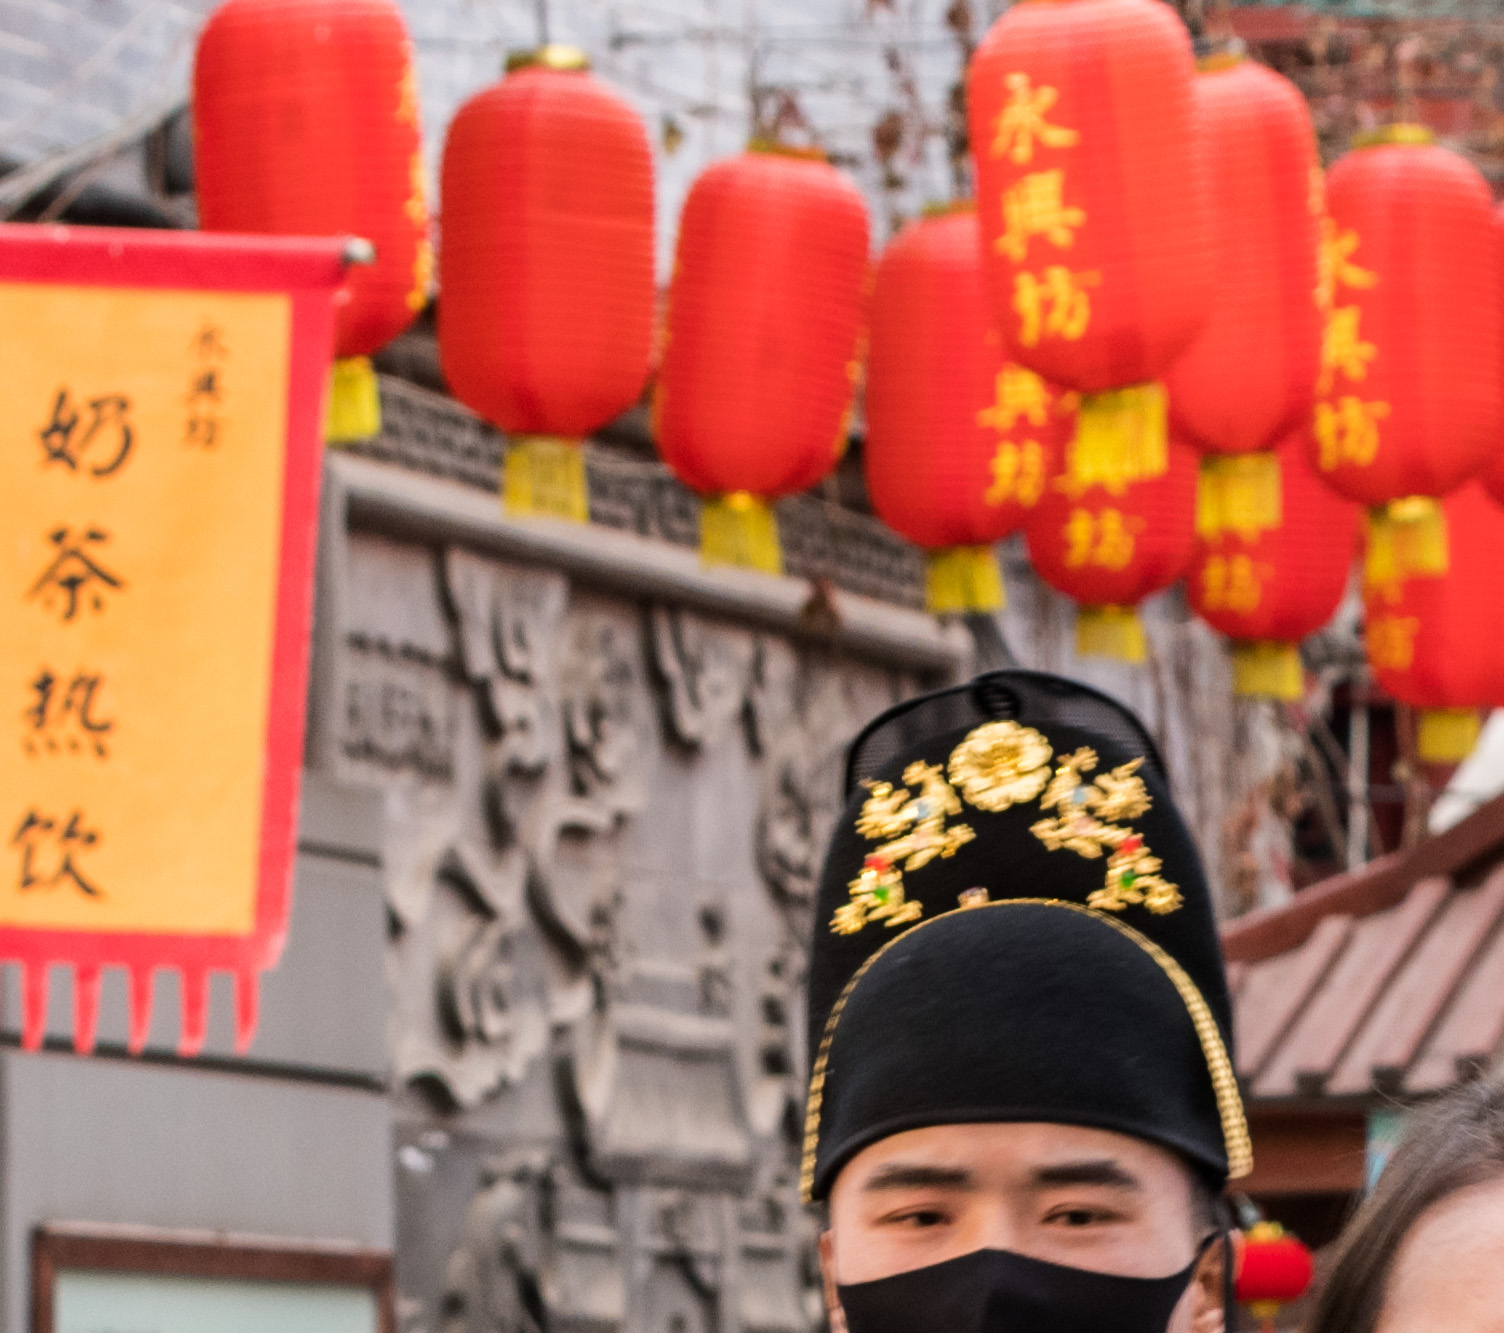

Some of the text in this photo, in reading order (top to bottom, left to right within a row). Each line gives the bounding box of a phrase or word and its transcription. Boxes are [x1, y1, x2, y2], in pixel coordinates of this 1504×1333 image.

[992, 71, 1102, 348] 永興坊
[977, 361, 1052, 508] 興坊
[11, 387, 139, 901] 奶茶热饮
